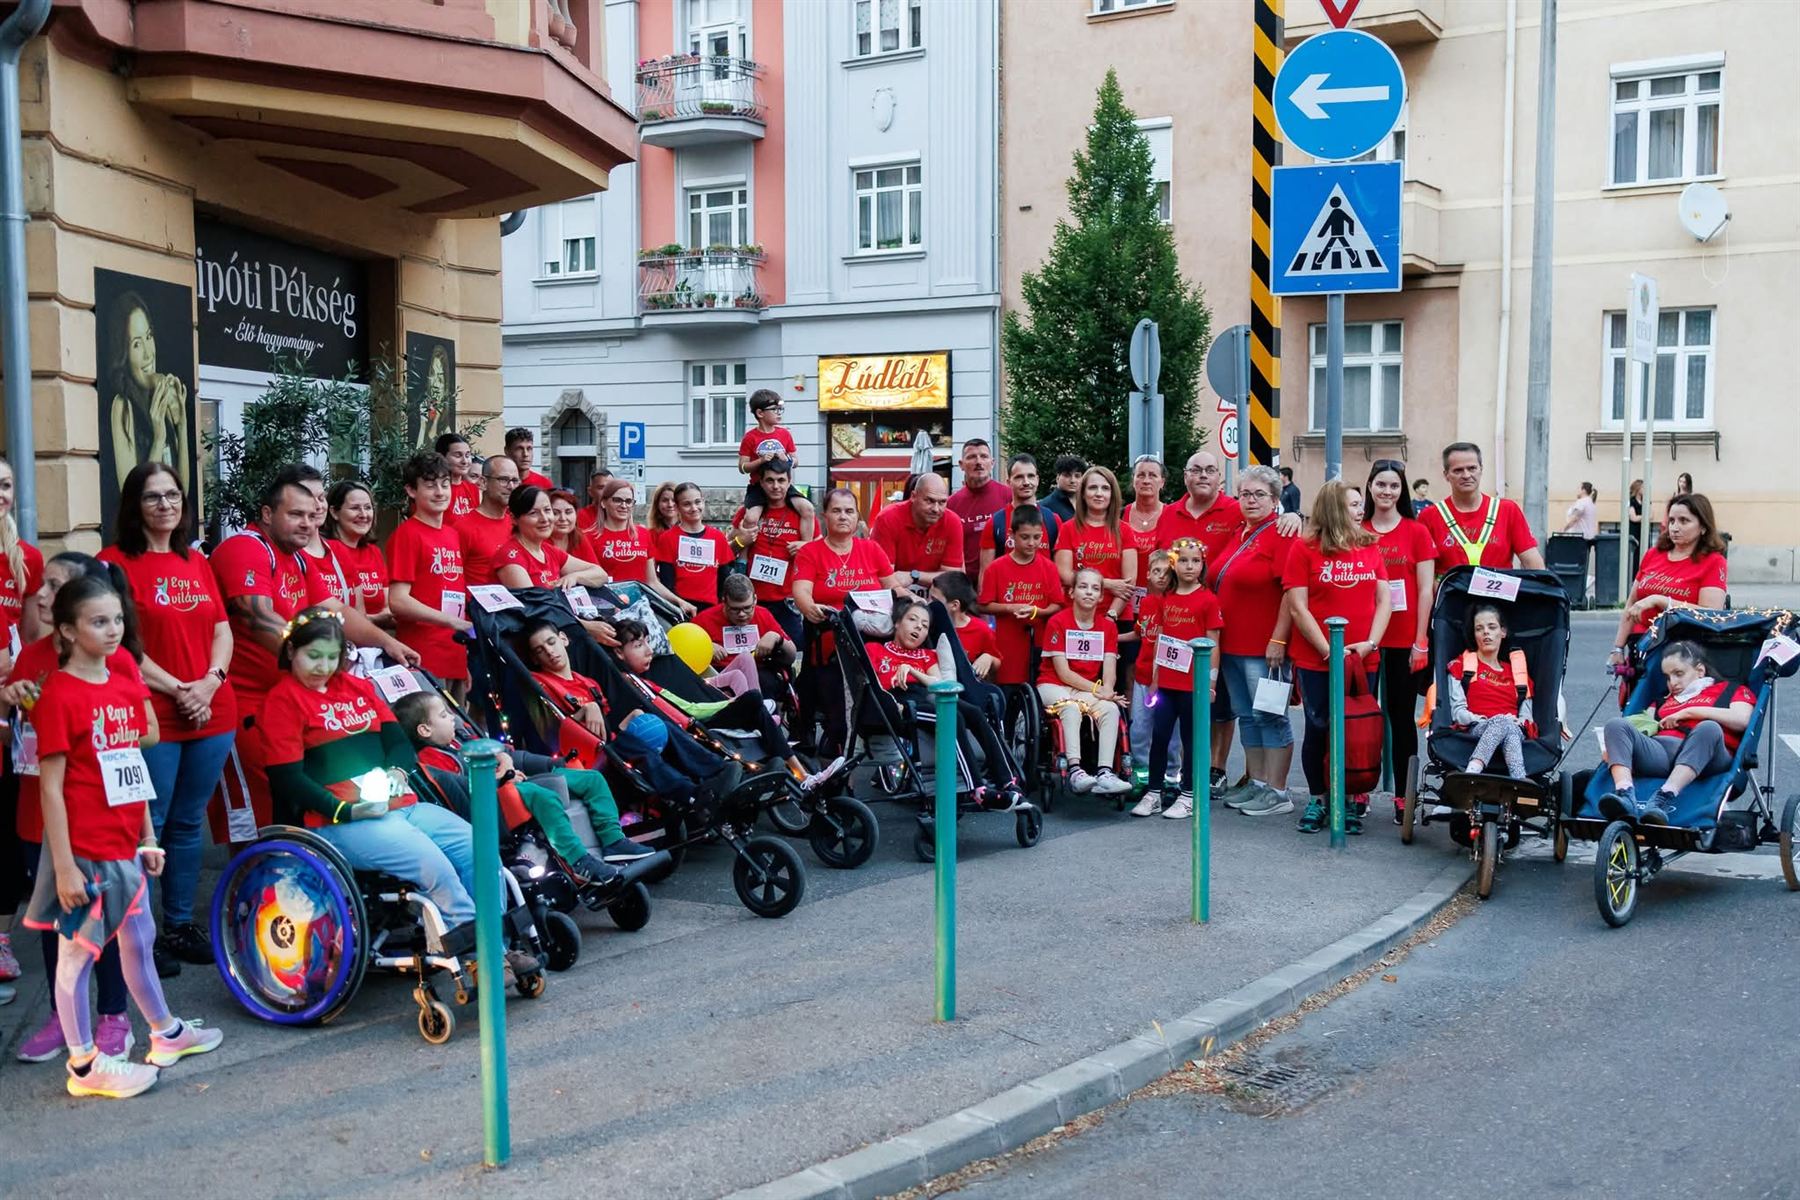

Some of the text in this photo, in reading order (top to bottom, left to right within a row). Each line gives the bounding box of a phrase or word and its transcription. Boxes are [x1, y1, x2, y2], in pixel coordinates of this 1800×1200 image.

[269, 263, 357, 339] Pékség
[256, 324, 316, 358] hagyomány
[831, 357, 937, 395] Lúdláb
[624, 425, 641, 456] P
[690, 546, 702, 556] 86
[760, 563, 779, 577] 7211
[1335, 560, 1354, 573] Egy
[171, 576, 201, 591] Egy a
[1486, 580, 1502, 591] 22
[735, 633, 748, 645] 85
[1078, 640, 1090, 651] 28
[1166, 646, 1179, 660] 65
